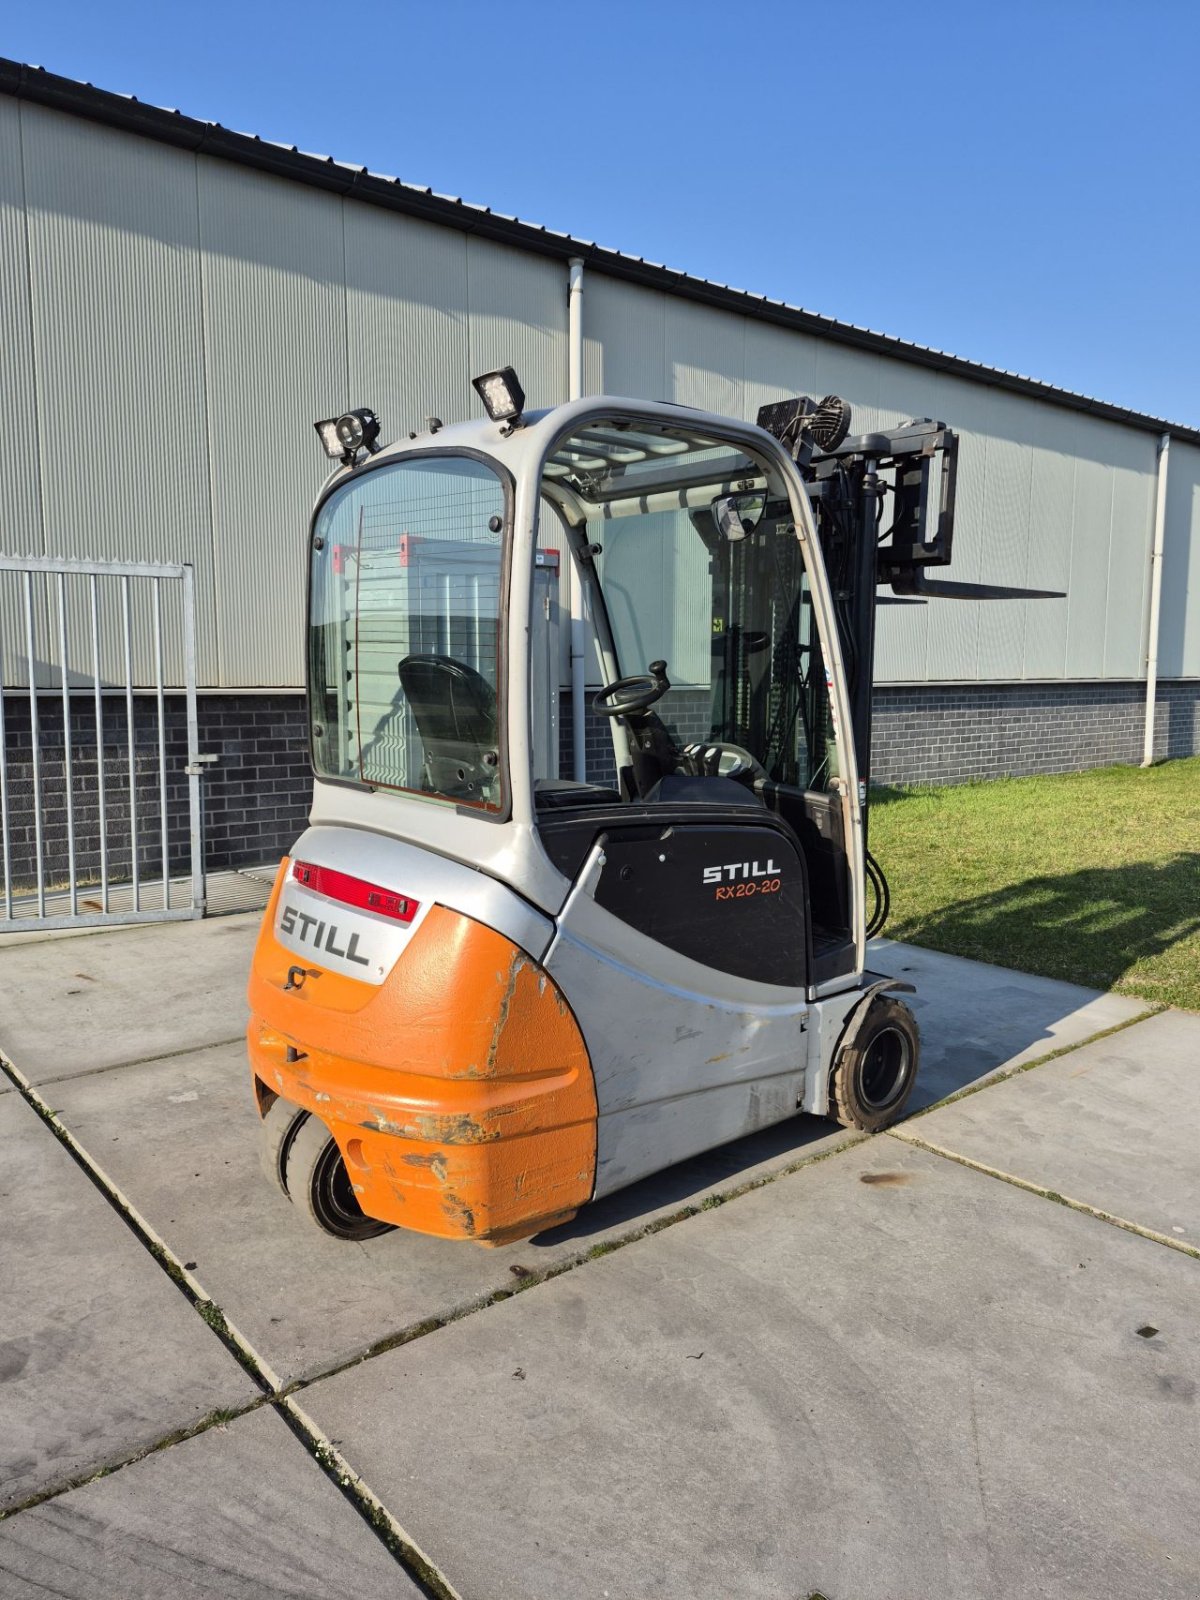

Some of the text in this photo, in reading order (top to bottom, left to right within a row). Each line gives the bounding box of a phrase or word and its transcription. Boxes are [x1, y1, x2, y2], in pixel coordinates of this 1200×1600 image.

[703, 859, 781, 884] STILL
[715, 879, 781, 901] RX20-20
[280, 906, 369, 966] STILL
